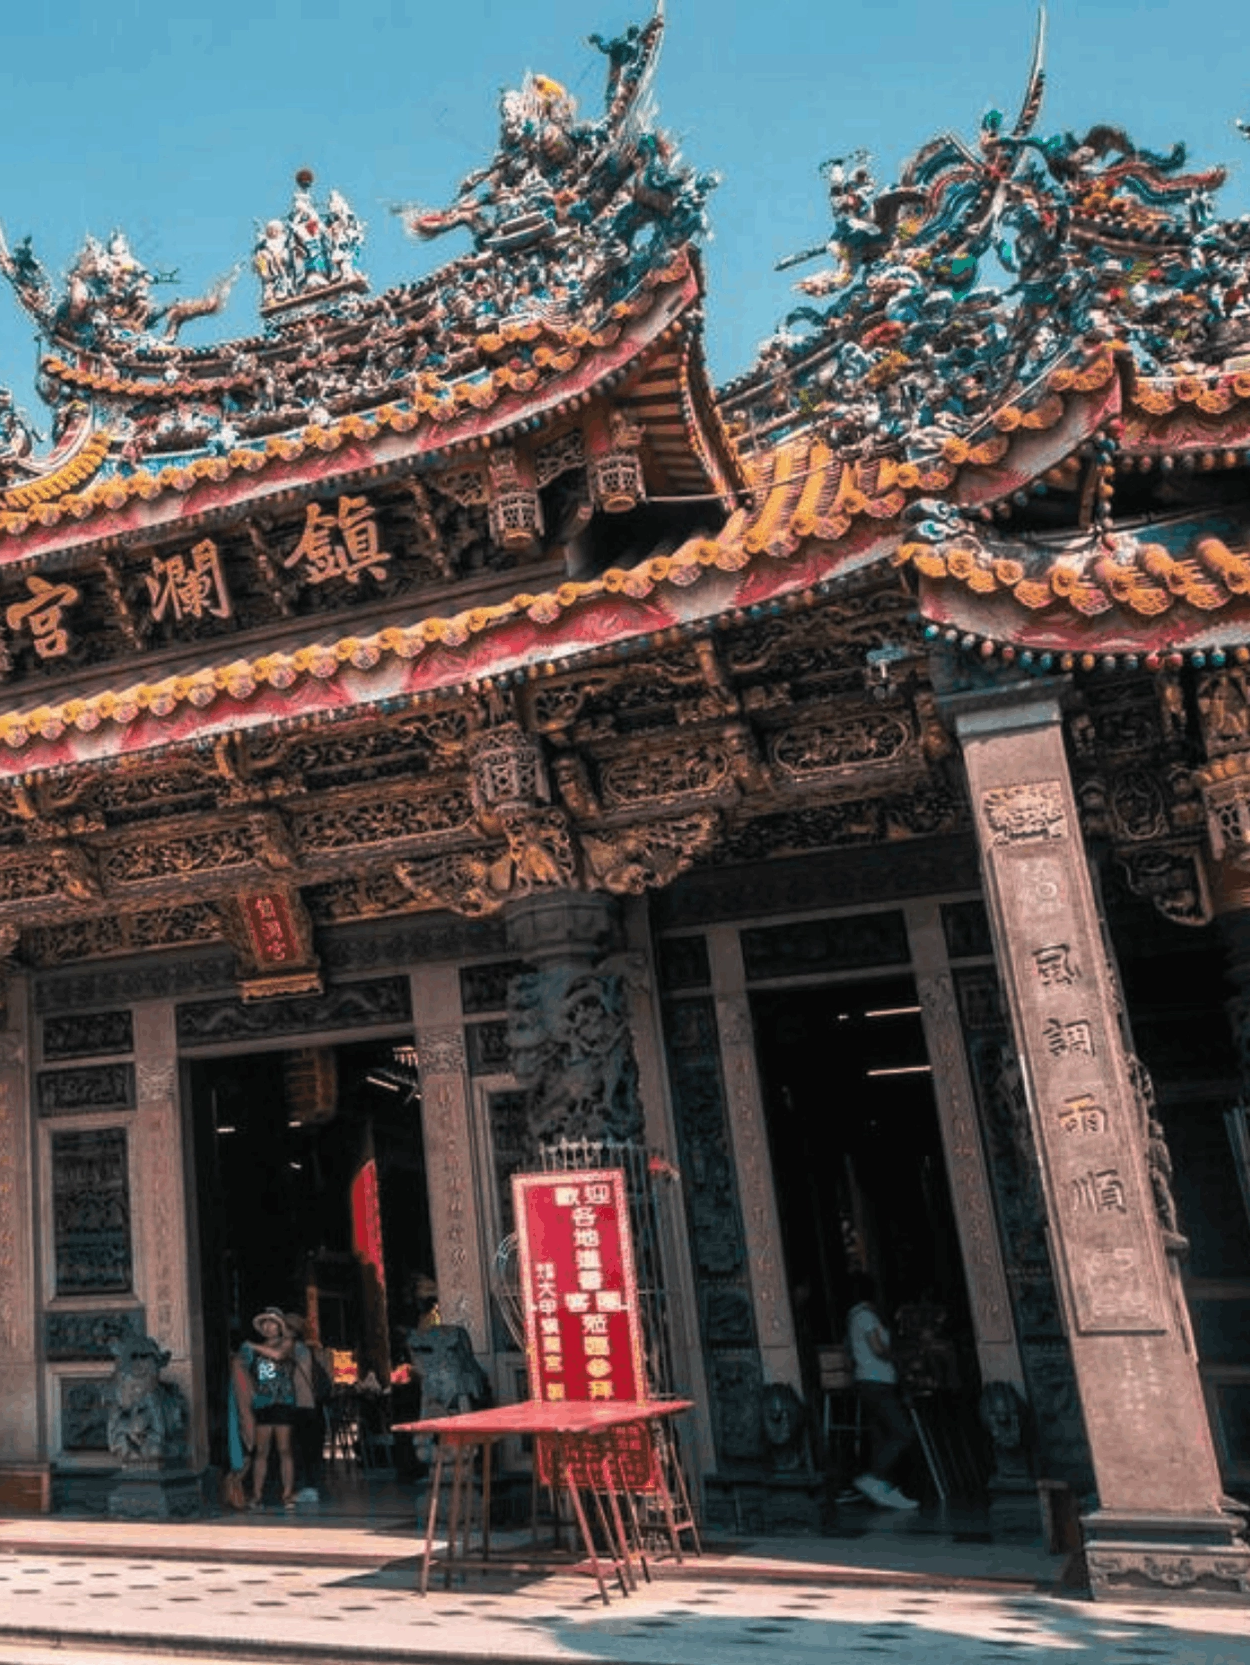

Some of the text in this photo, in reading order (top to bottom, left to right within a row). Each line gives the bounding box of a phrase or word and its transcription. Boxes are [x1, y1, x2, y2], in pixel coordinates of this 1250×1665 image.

[6, 495, 392, 659] 鎮瀾宮
[1031, 943, 1127, 1213] 風調雨順
